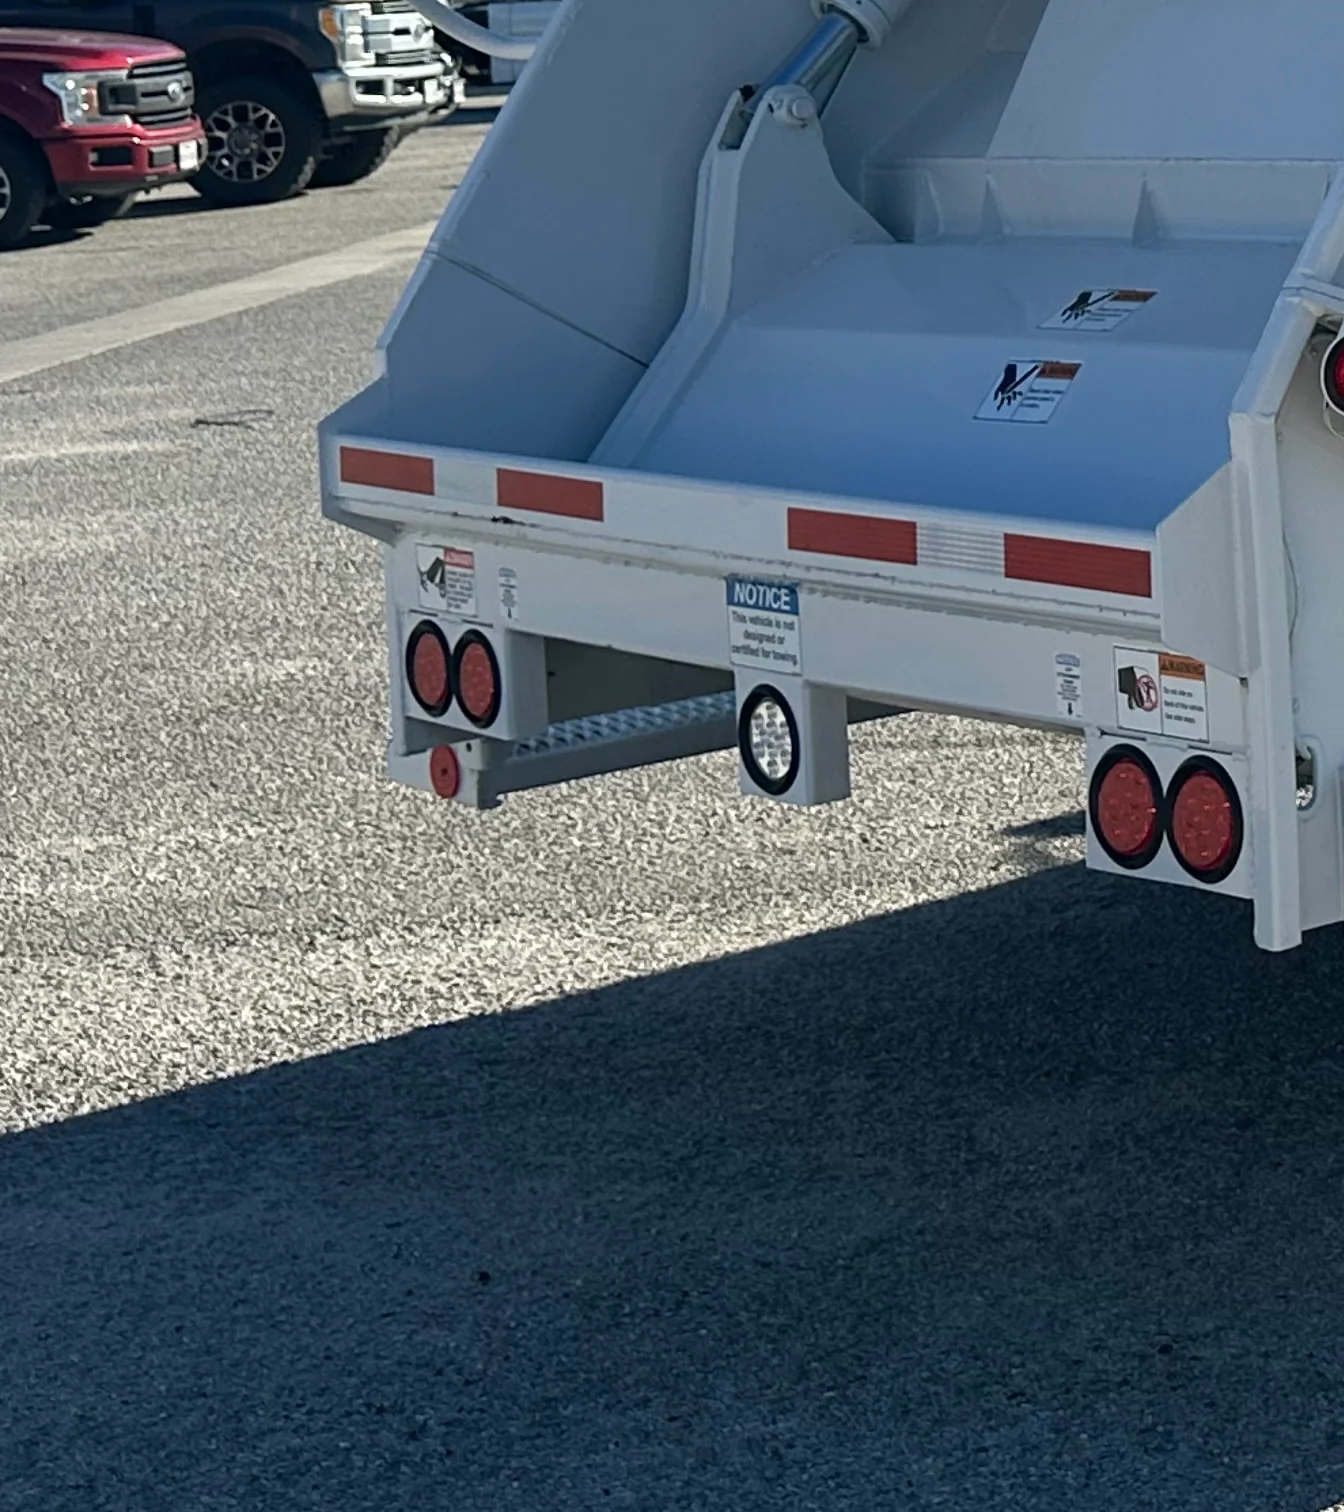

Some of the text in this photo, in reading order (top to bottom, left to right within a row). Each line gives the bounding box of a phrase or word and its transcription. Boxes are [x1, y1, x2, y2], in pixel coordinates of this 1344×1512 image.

[734, 582, 792, 611] NOTICE
[731, 610, 795, 631] This vehicle is not
[743, 629, 785, 645] designed or
[731, 644, 760, 658] certified
[761, 647, 772, 659] for
